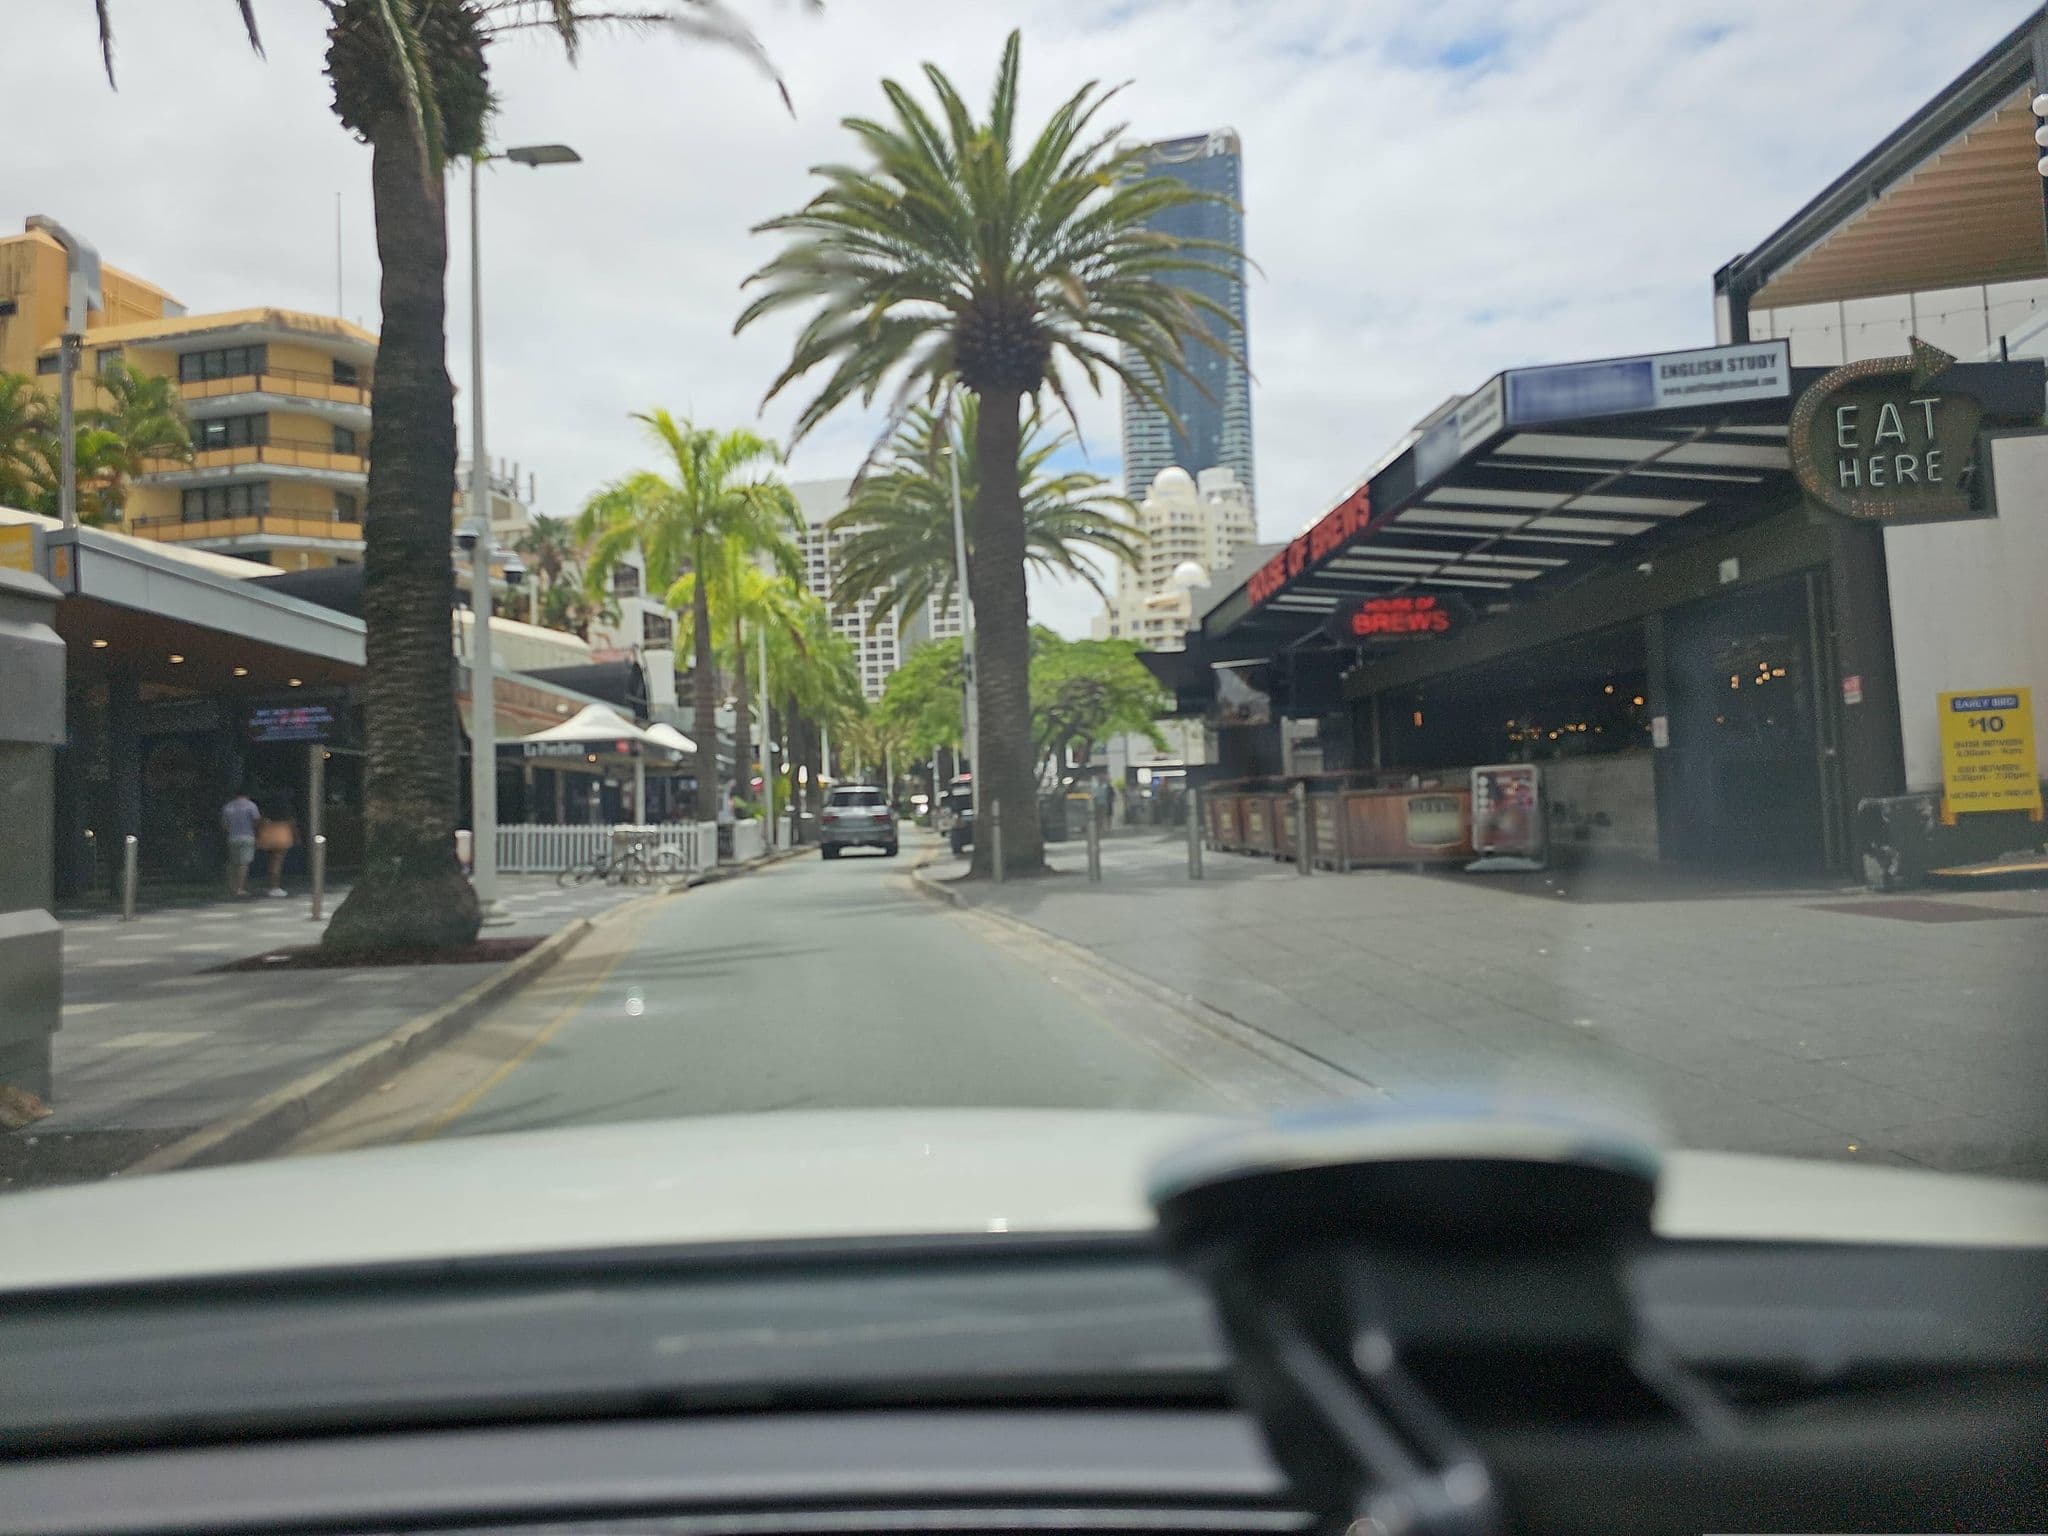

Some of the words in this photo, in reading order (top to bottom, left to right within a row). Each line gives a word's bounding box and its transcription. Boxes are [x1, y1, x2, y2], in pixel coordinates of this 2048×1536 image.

[1661, 359, 1723, 379] ENGLISH
[1726, 353, 1777, 371] STUDY
[1836, 397, 1942, 449] EAT
[1839, 449, 1944, 489] HERE
[1955, 698, 1990, 710] EARLY
[1968, 716, 2005, 733] $10
